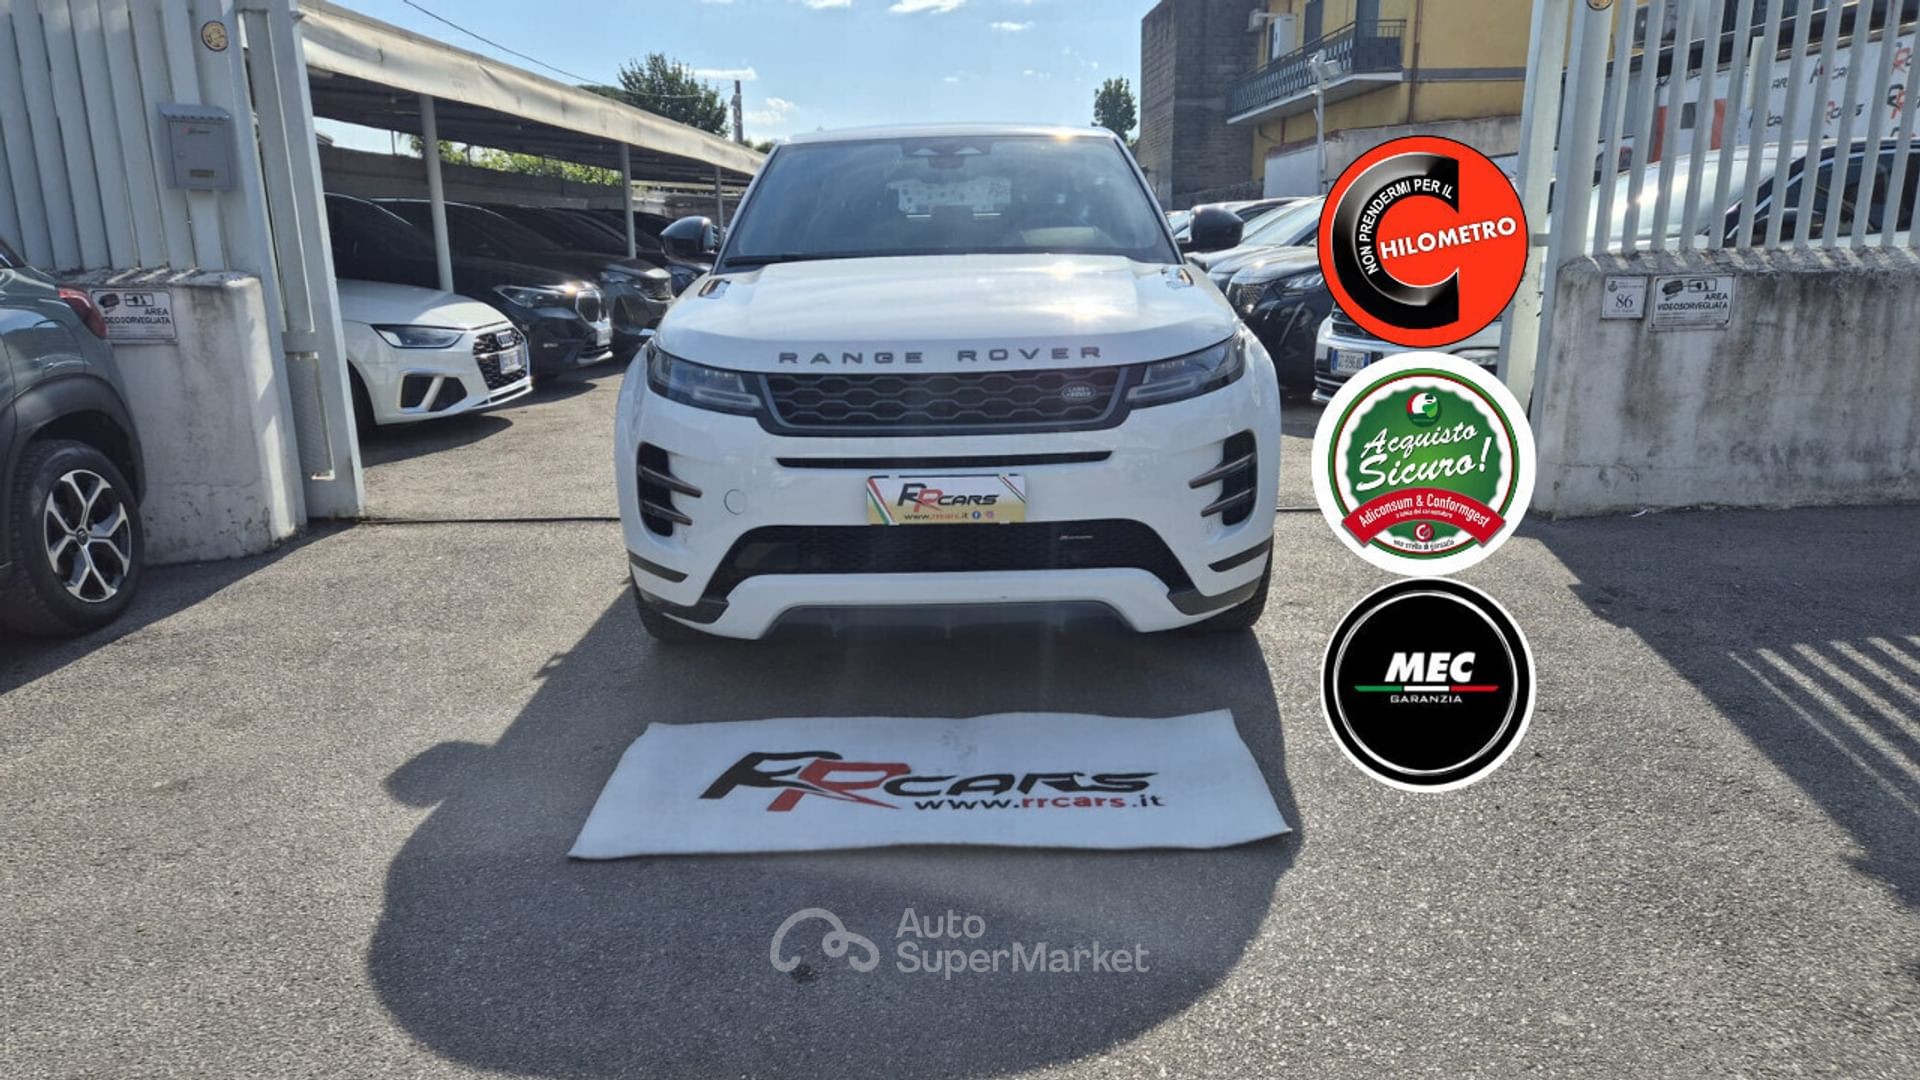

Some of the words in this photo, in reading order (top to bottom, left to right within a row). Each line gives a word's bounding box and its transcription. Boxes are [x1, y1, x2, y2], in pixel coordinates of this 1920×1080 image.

[1615, 294, 1633, 309] 86
[1704, 293, 1728, 301] AREA
[1657, 302, 1728, 311] VIDEOSORVEGLIATA
[103, 316, 171, 325] DEOSORVEGLIATA
[778, 352, 924, 365] RANGE
[957, 346, 1102, 362] ROVER
[914, 793, 1167, 811] www.rrcars.it
